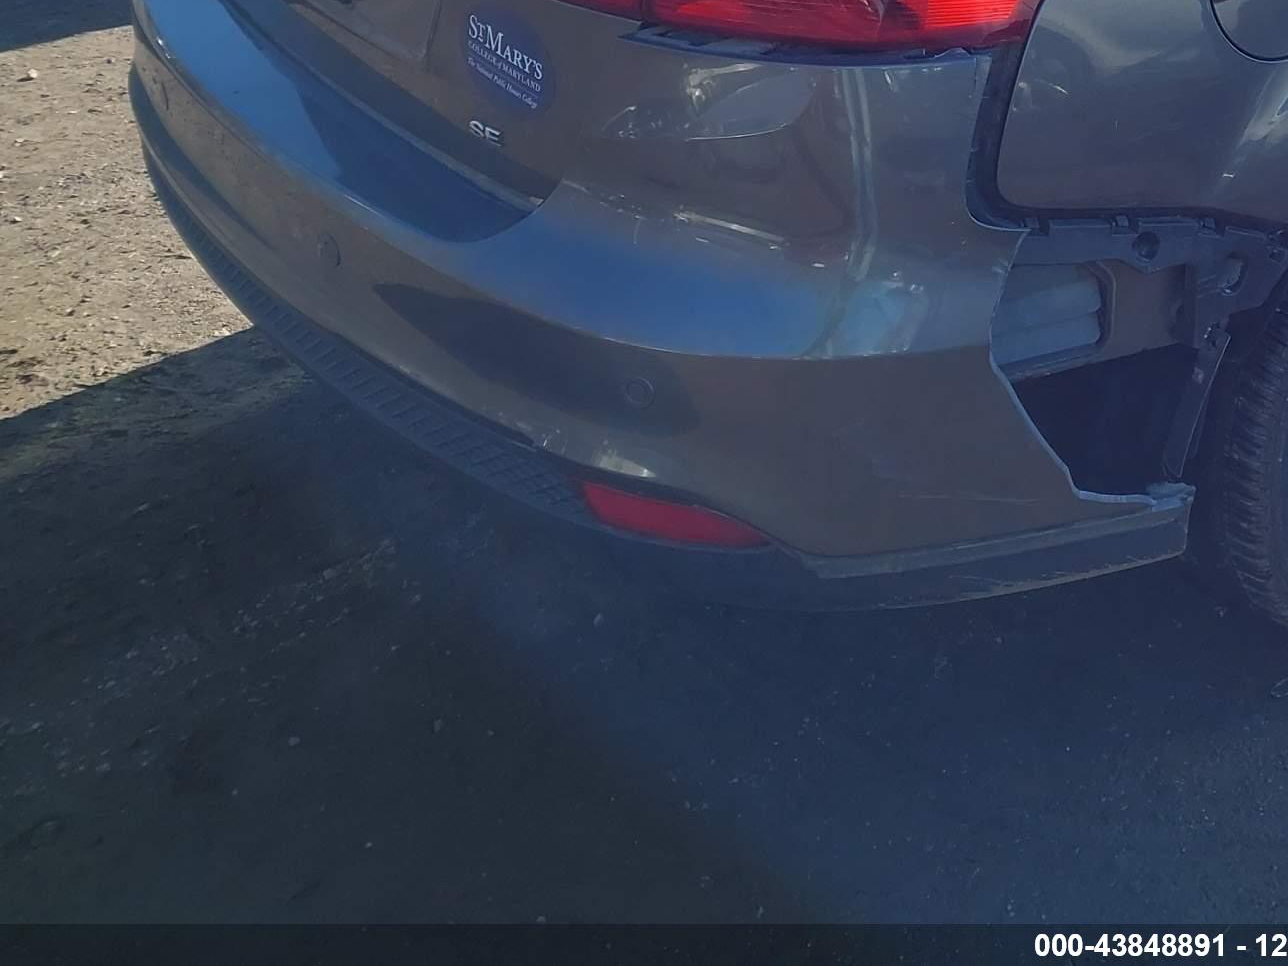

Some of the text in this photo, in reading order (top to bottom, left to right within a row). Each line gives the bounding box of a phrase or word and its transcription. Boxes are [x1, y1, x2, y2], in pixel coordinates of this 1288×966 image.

[485, 25, 542, 79] MARY'S
[503, 65, 541, 92] MARYLAND
[469, 120, 501, 146] SE
